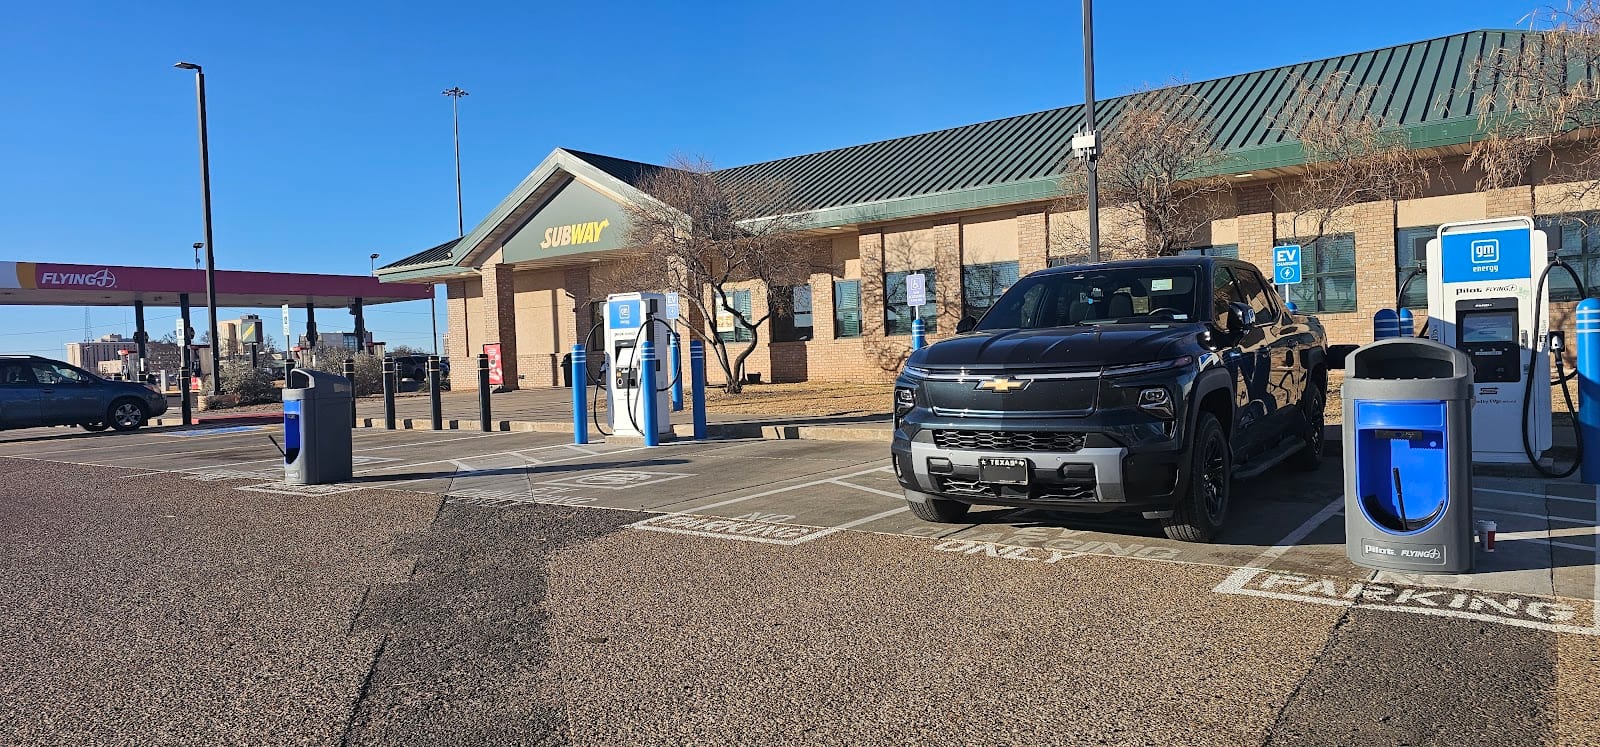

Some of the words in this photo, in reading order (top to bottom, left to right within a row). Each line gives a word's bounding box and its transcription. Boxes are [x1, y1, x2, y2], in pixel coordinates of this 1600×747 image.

[540, 218, 610, 249] SUBWAY
[1277, 249, 1297, 261] EV
[1475, 245, 1495, 257] gm
[934, 540, 1086, 564] ONLY
[1259, 574, 1577, 621] PARKING
